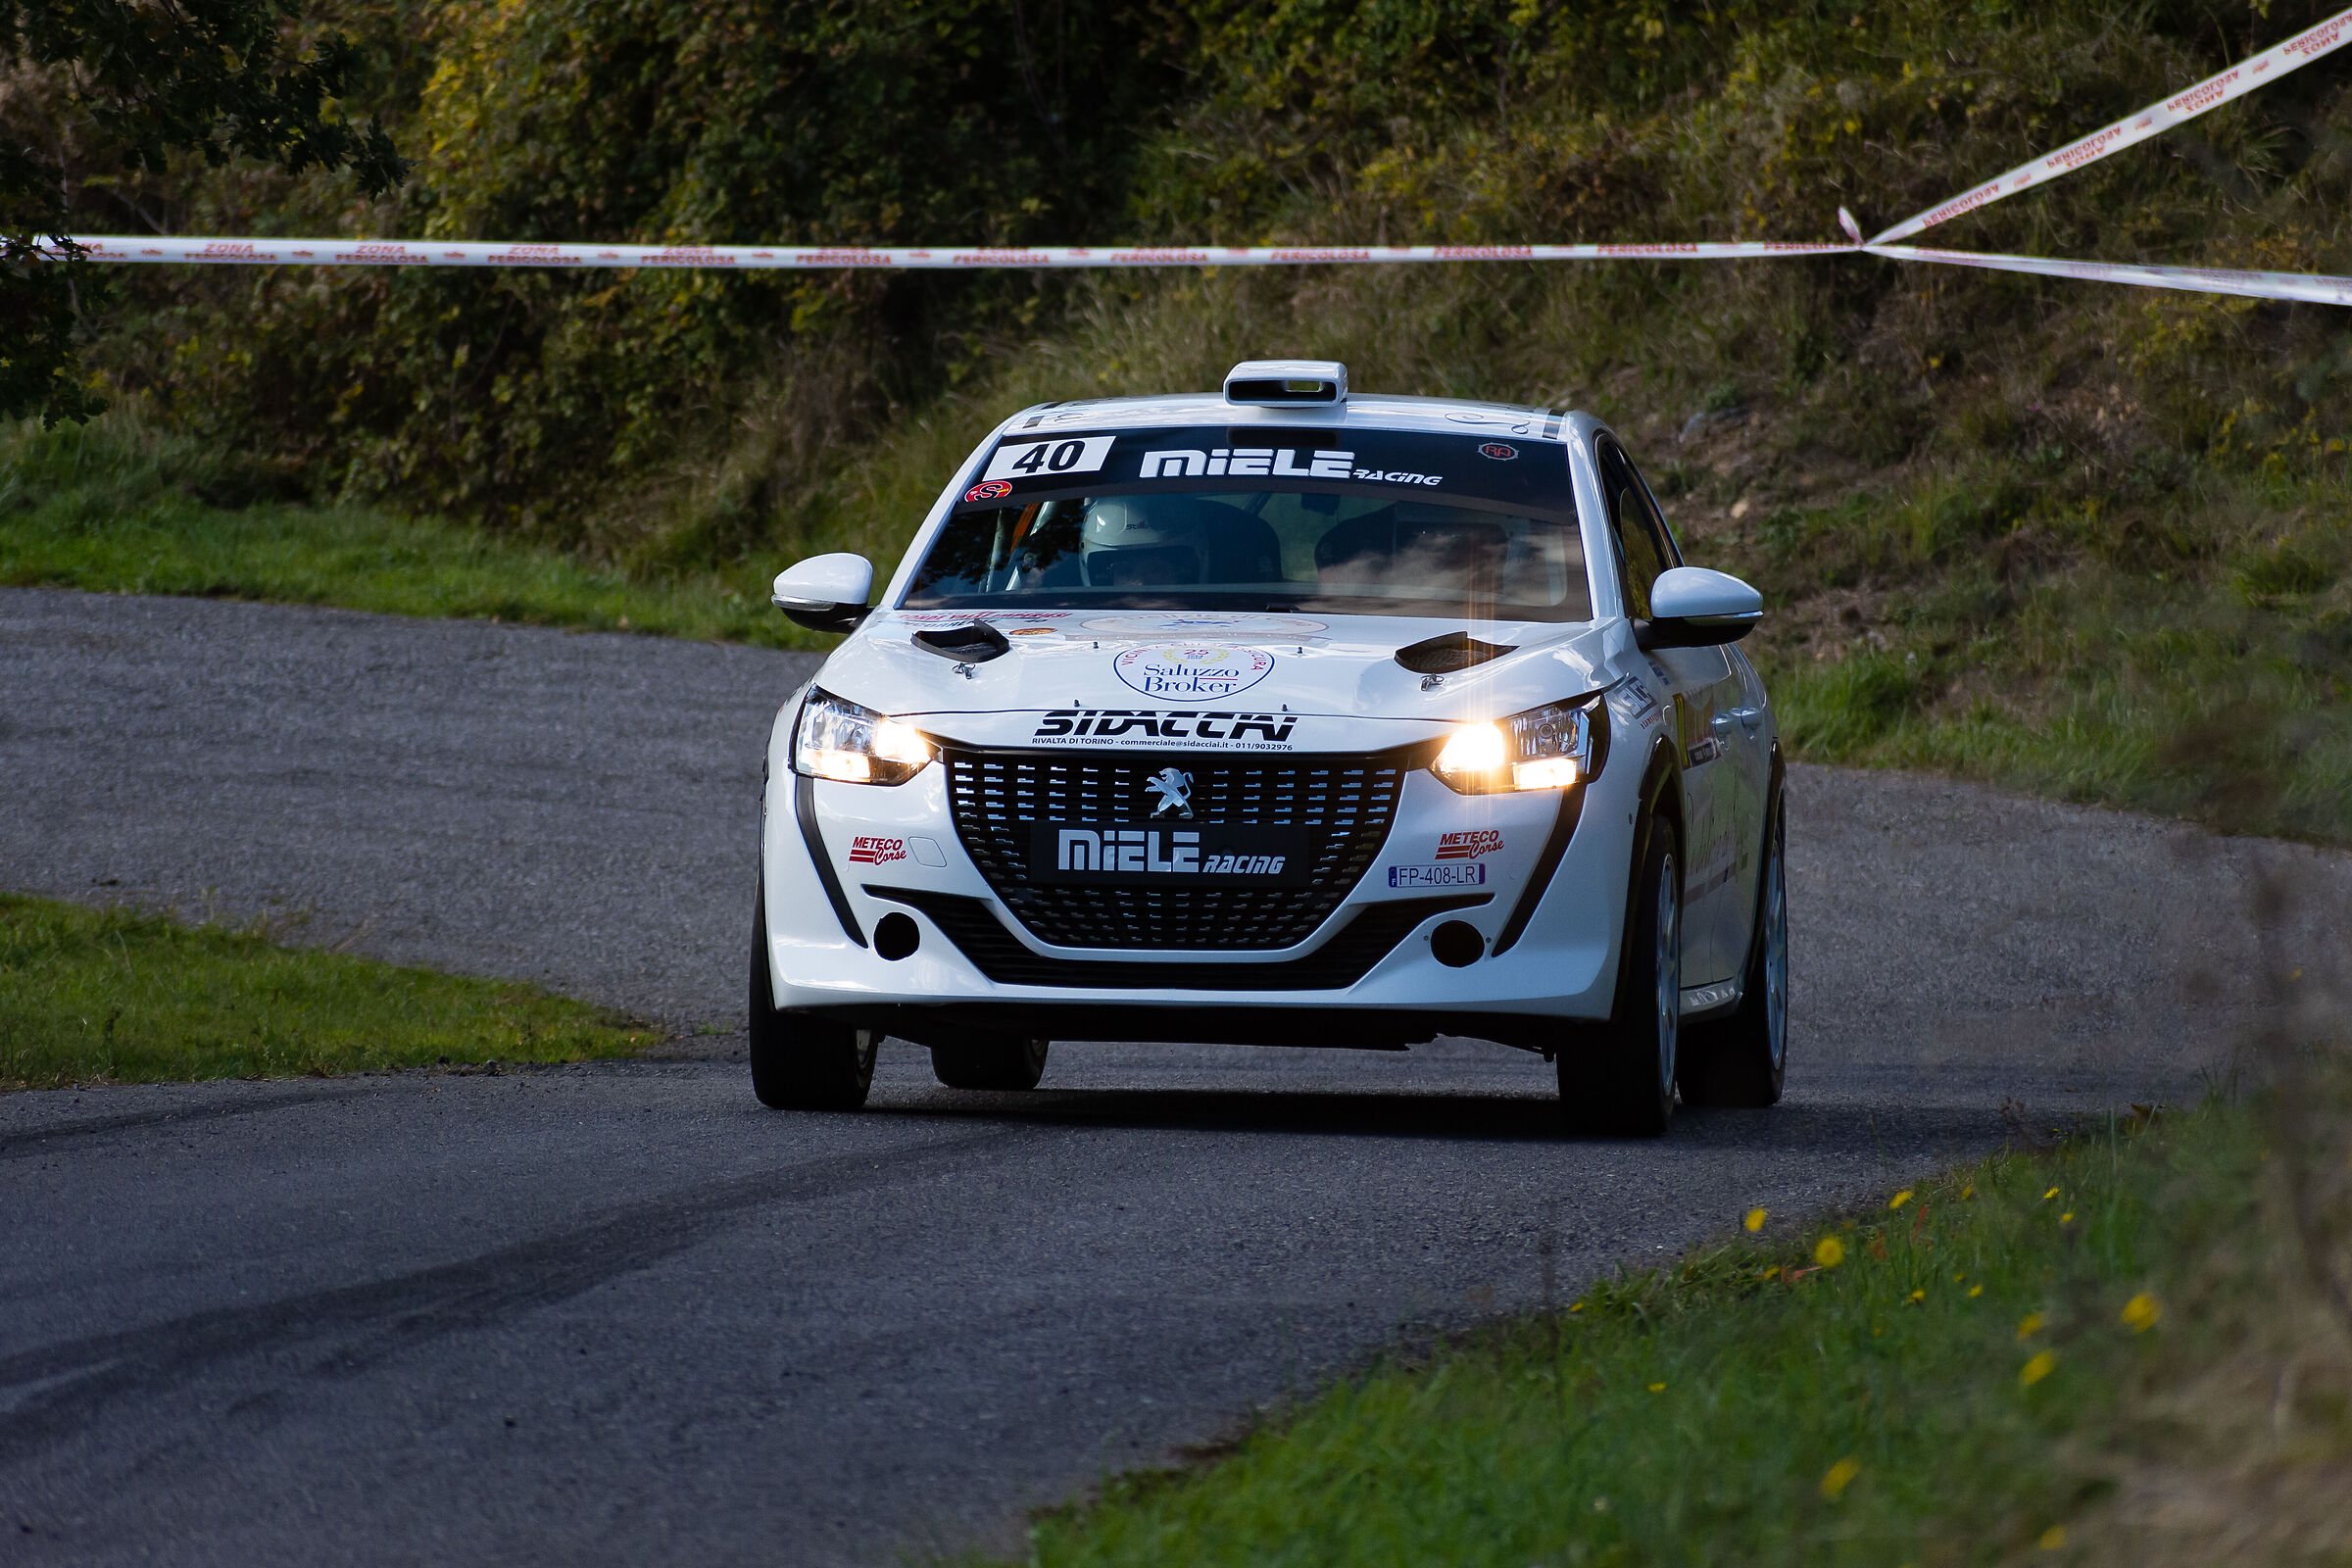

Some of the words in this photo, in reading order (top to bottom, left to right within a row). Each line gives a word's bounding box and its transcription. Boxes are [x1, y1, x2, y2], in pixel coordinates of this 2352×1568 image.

[204, 244, 255, 253] ZONA
[357, 245, 406, 254] ZONA
[508, 245, 560, 254] ZONA
[1433, 246, 1533, 258] PERICOLOSA
[1596, 244, 1698, 254] PERICOLOSA
[336, 254, 429, 263] PERICOLOSA
[488, 255, 582, 264] PERICOLOSA
[642, 255, 736, 264] PERICOLOSA
[797, 255, 892, 265] PERICOLOSA
[952, 255, 1050, 265] PERICOLOSA
[1110, 252, 1208, 262] PERICOLOSA
[1271, 250, 1370, 261] PERICOLOSA
[1012, 440, 1087, 473] 40
[1144, 663, 1240, 677] Saluzzo
[1144, 676, 1237, 693] Broker
[1120, 739, 1229, 749] commerciale@sidacciai.it
[1236, 742, 1293, 752] 011/9032976
[852, 836, 904, 851] METECO
[1440, 830, 1500, 846] METECO
[1468, 839, 1505, 859] Corse
[874, 849, 906, 866] Corse
[1202, 855, 1287, 874] RACING
[1398, 866, 1476, 885] FP-408-LR
